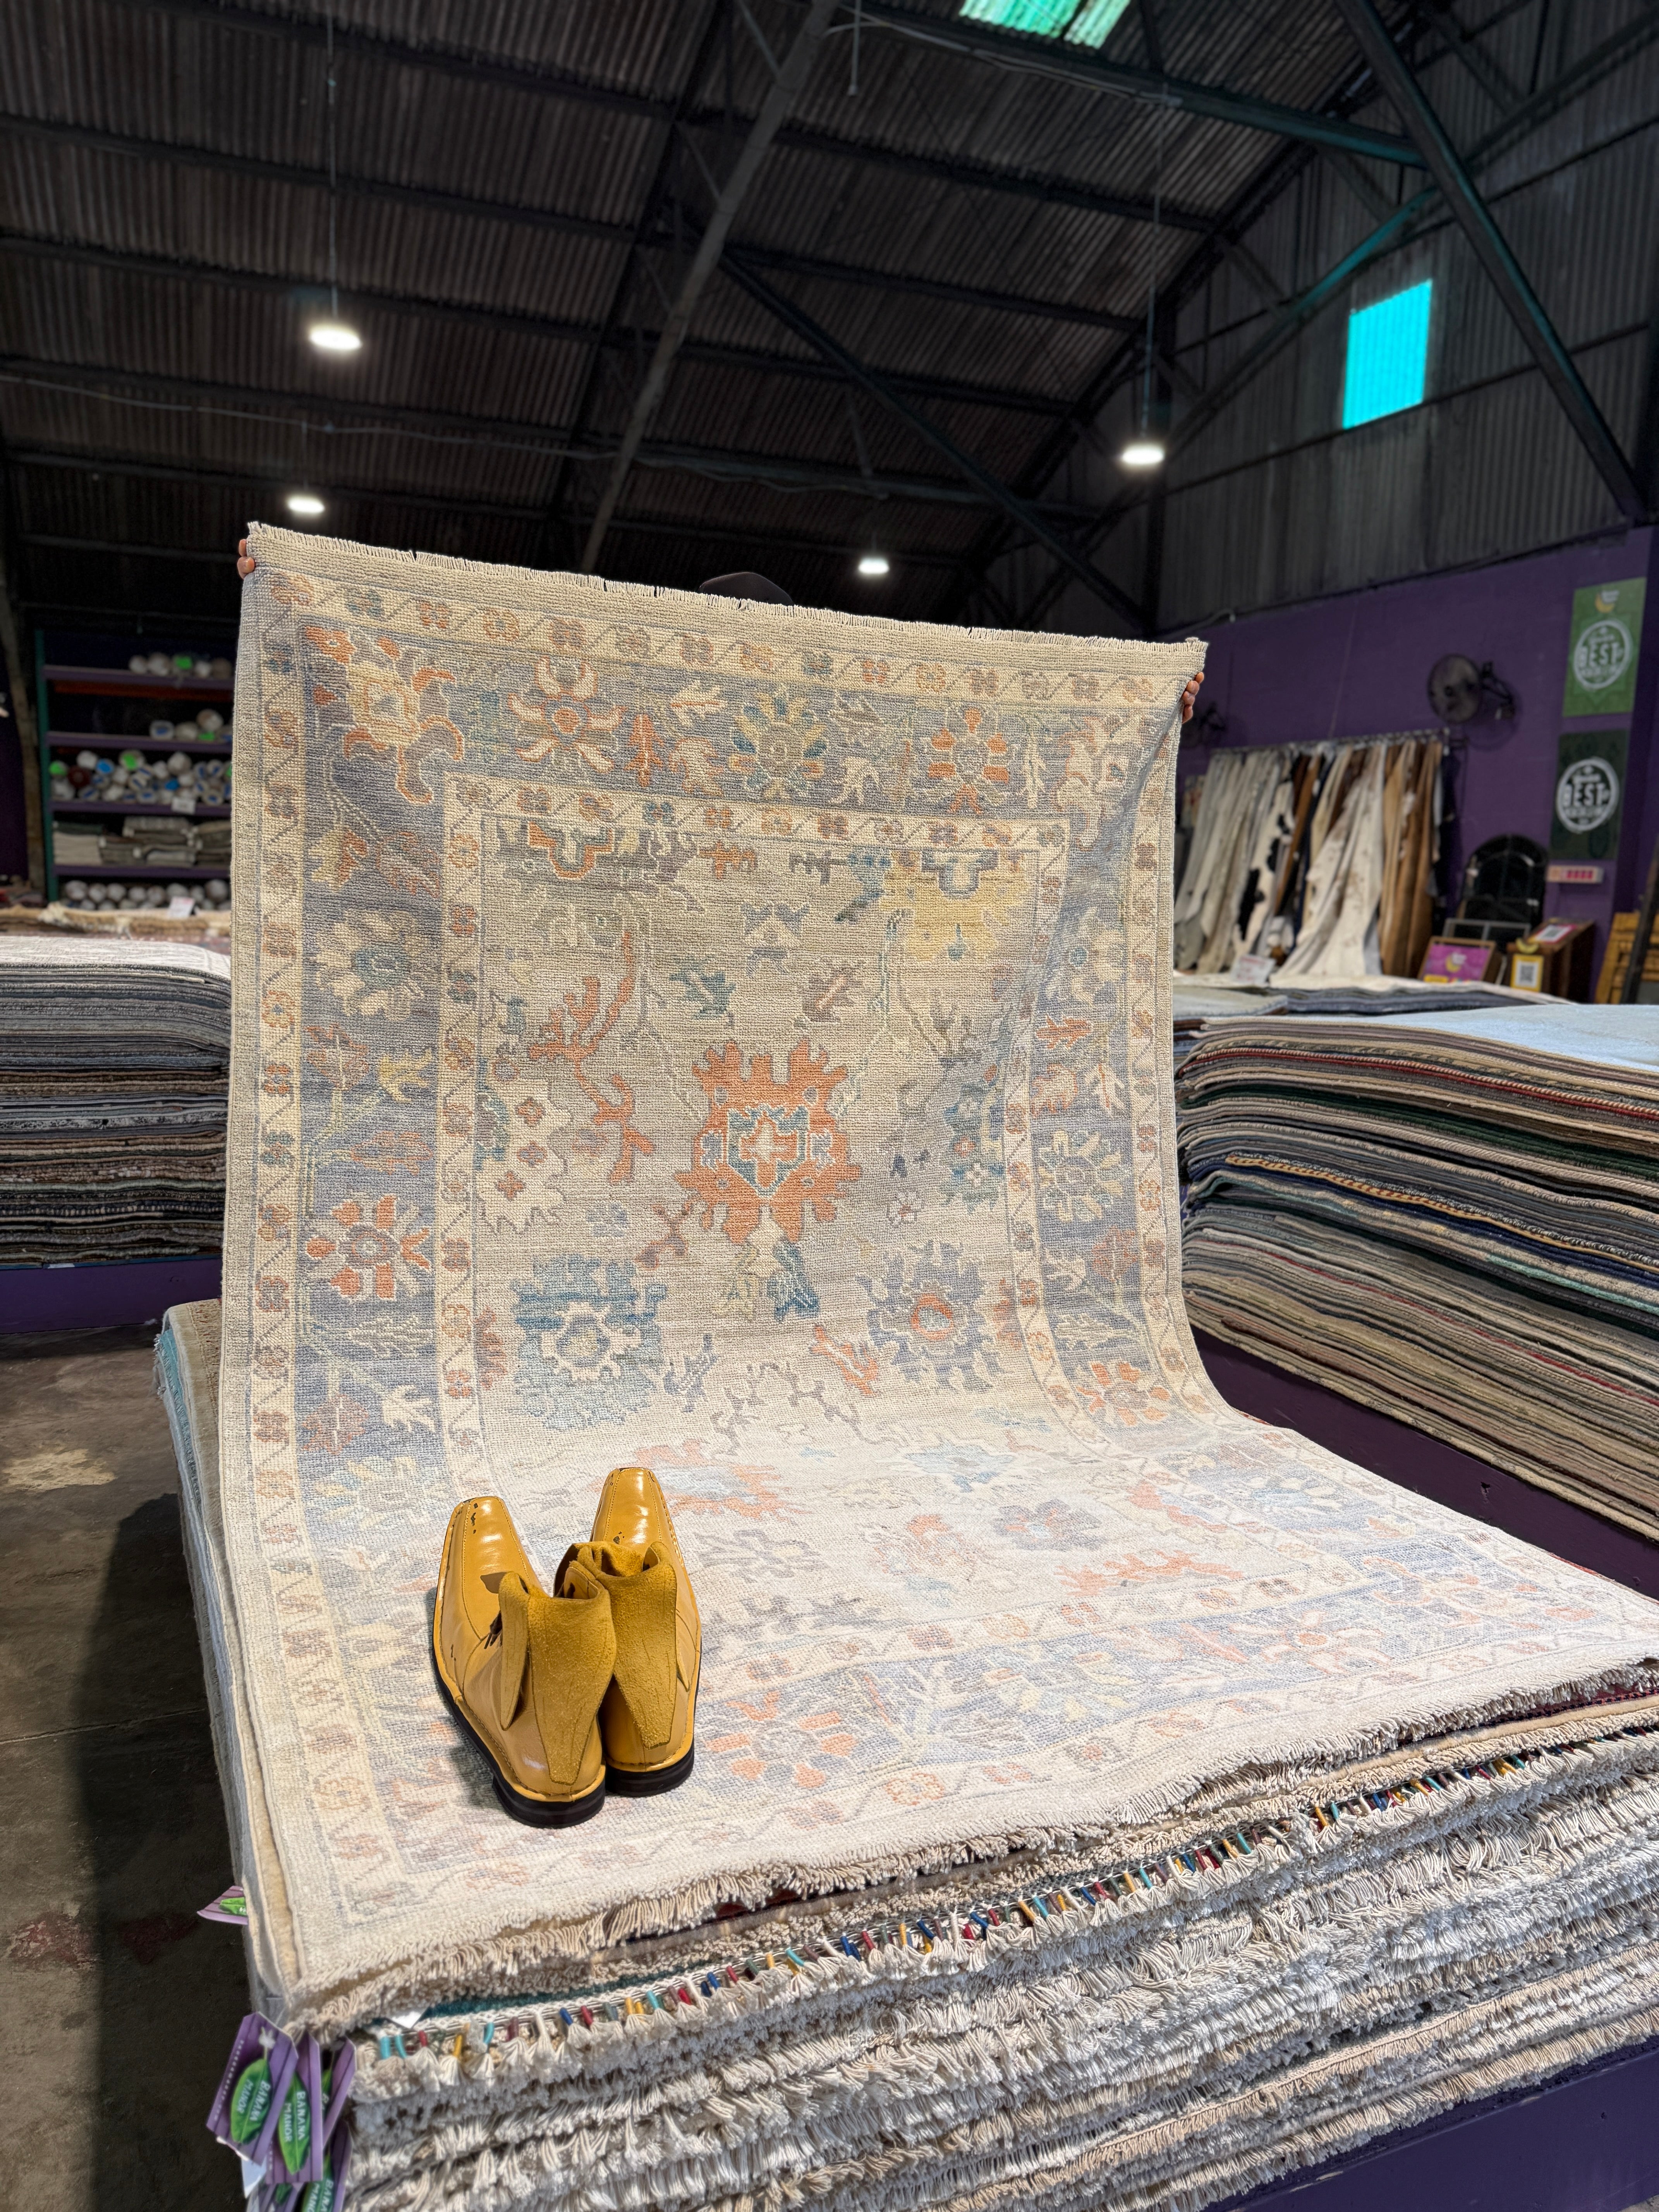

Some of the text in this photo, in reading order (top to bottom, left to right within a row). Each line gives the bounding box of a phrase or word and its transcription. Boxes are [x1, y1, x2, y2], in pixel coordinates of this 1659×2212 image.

[237, 2079, 253, 2113] MANOR
[250, 2080, 270, 2121] BANANA
[297, 2091, 306, 2140] BANANA
[284, 2102, 292, 2142] MANOR
